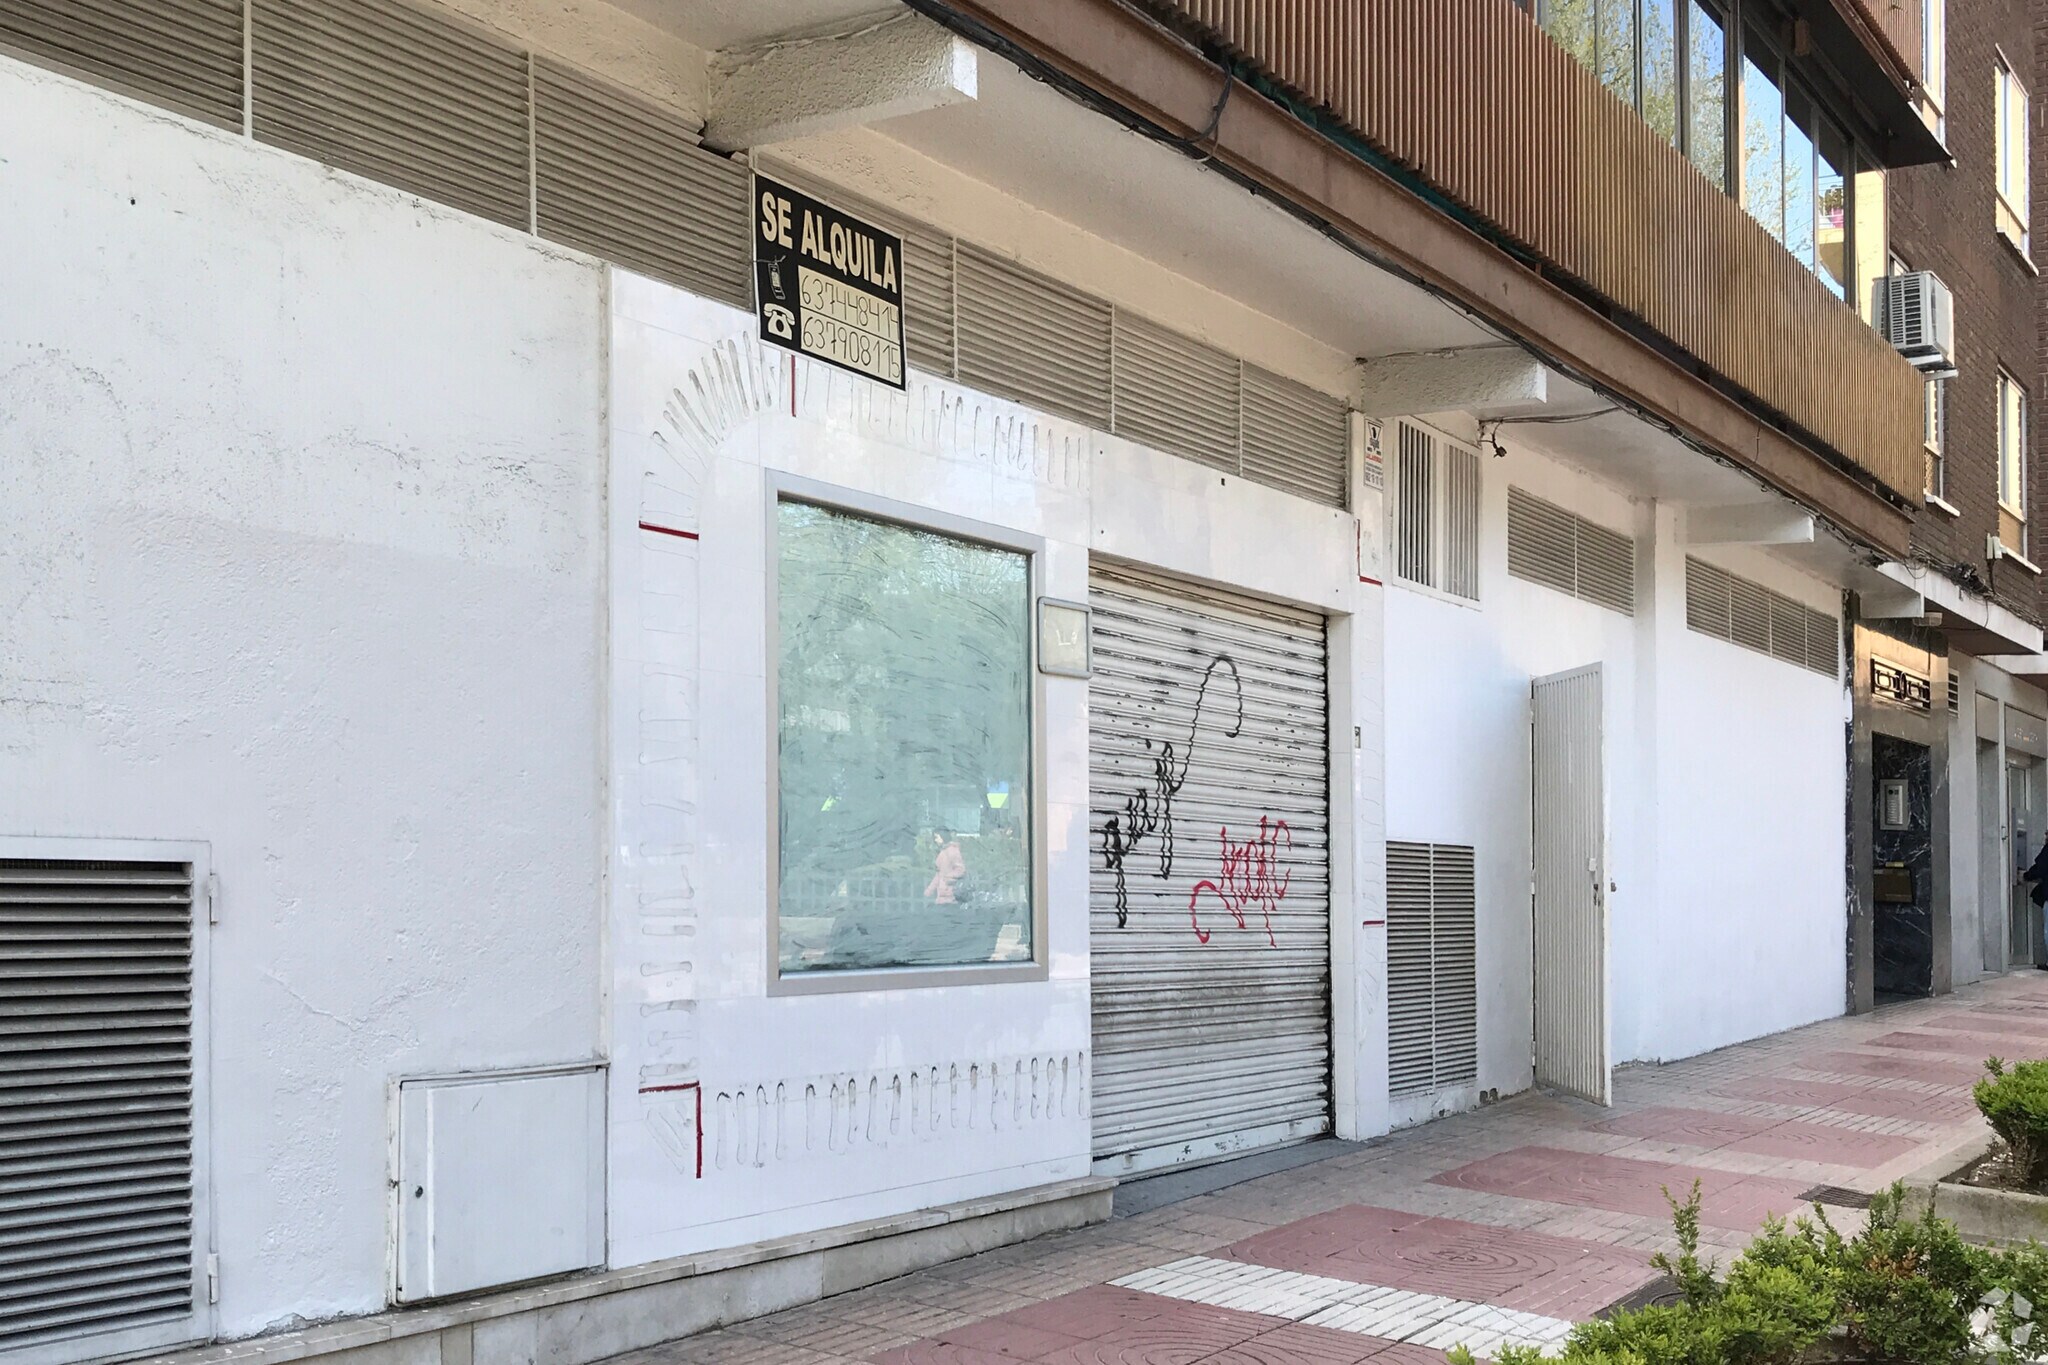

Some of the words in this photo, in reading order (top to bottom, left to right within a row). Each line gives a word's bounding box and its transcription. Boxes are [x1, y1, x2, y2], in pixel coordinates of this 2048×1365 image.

[761, 191, 793, 250] SE
[801, 208, 898, 294] ALQUILA
[802, 315, 901, 380] 637908115
